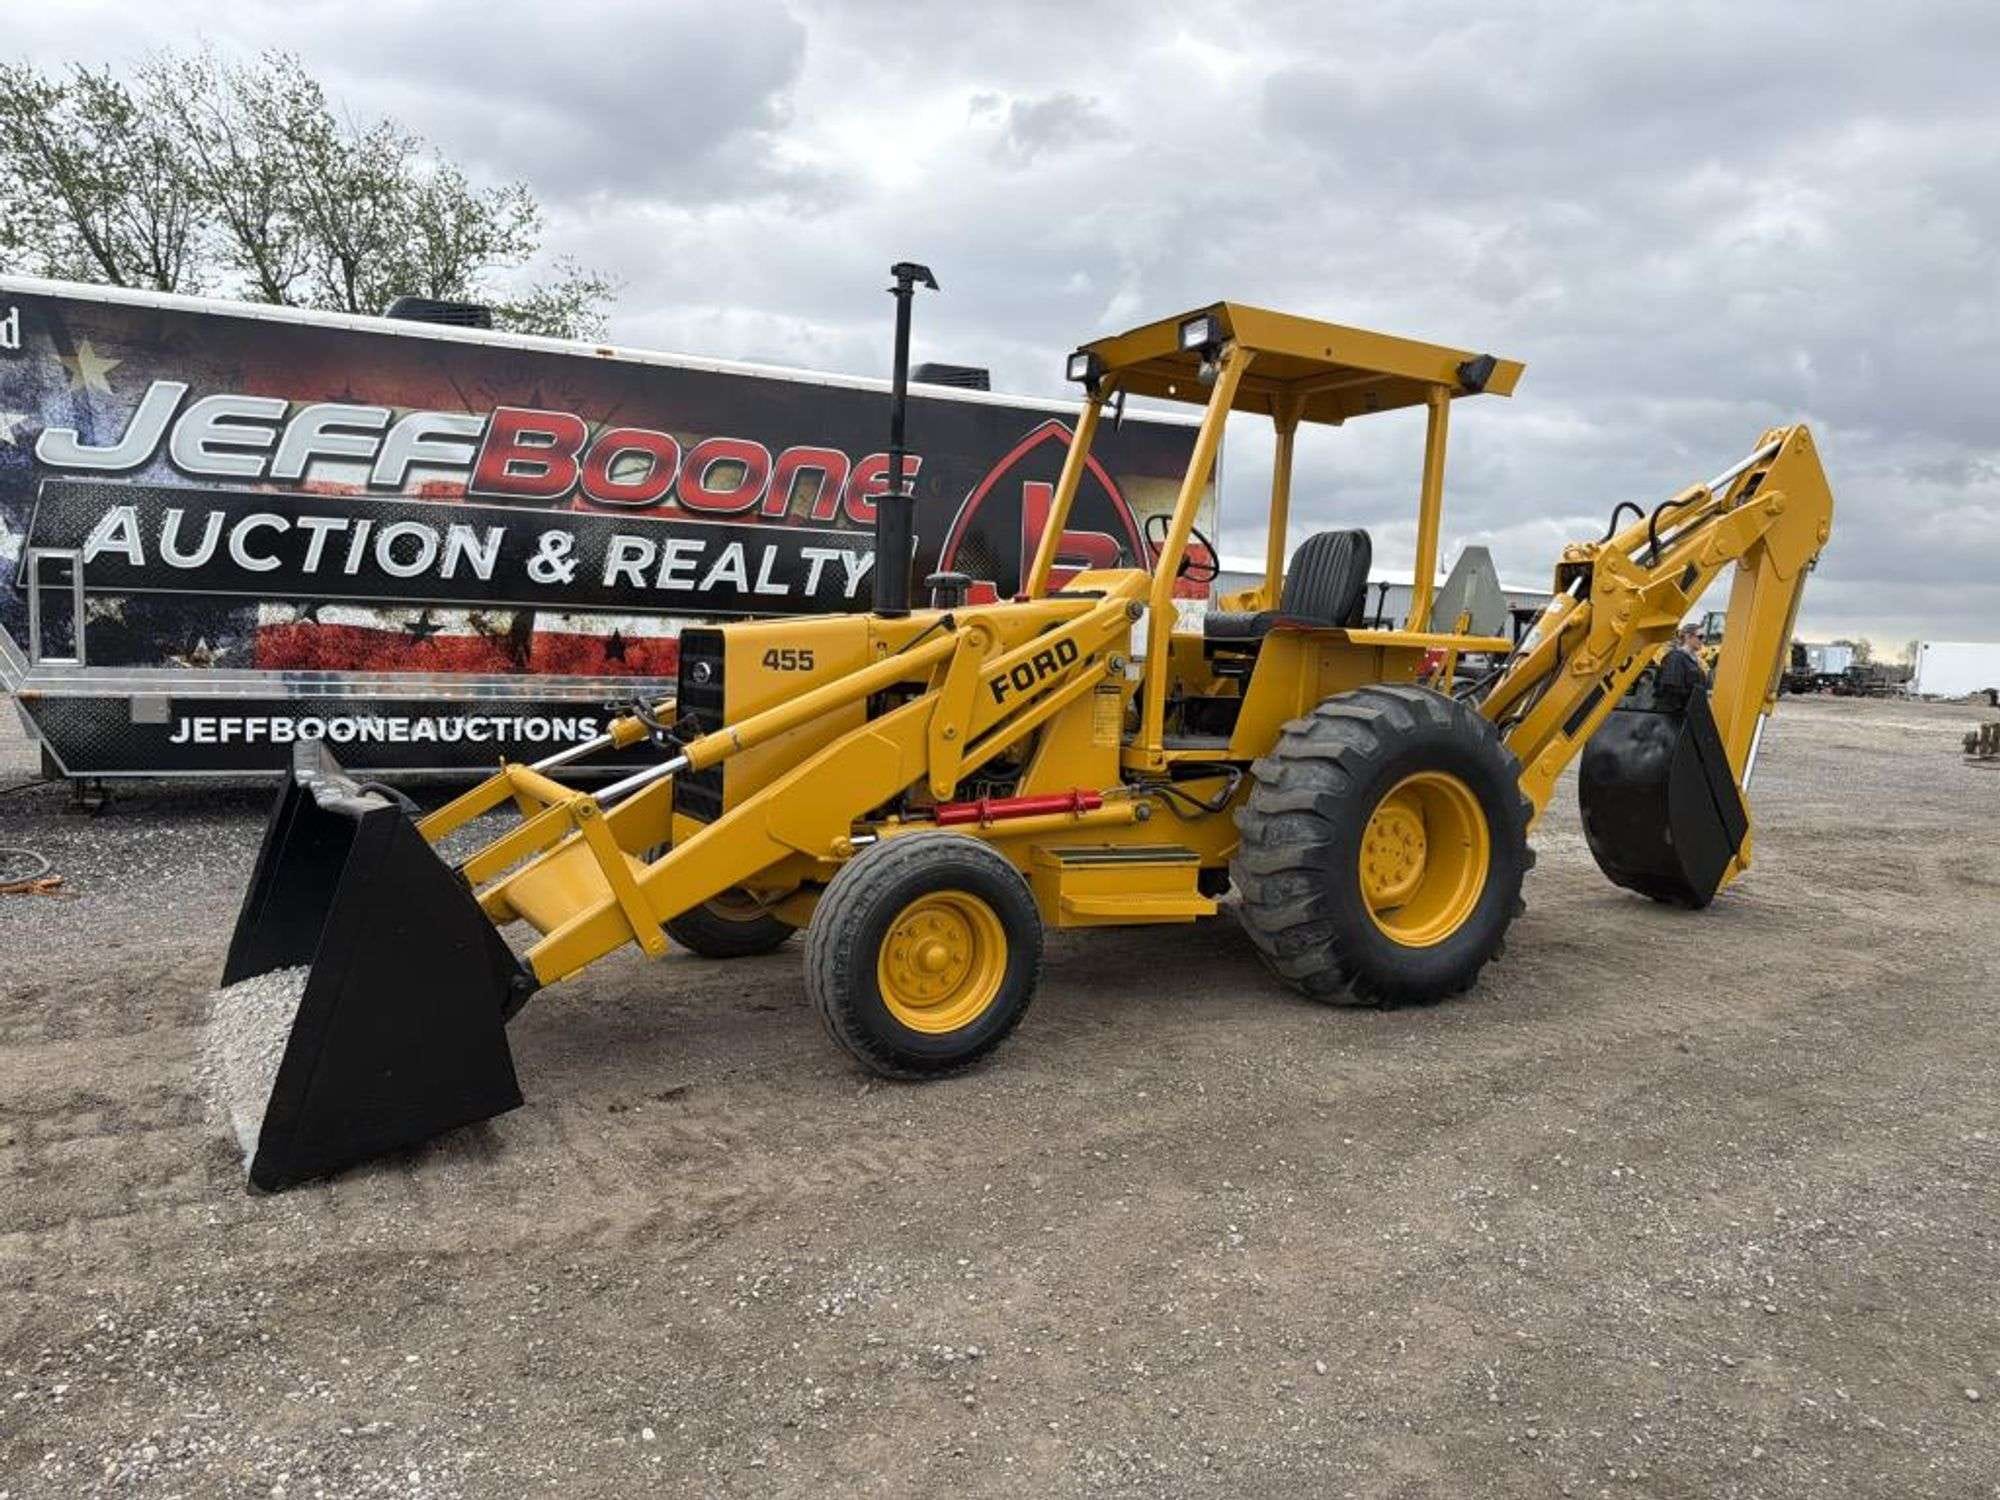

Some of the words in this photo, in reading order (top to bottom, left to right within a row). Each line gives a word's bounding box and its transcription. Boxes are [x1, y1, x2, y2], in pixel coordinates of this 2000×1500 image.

[82, 504, 507, 582] AUCTION
[526, 530, 580, 585] &
[602, 534, 876, 599] REALTY
[762, 648, 815, 672] 455
[989, 636, 1079, 705] FORD
[168, 716, 599, 744] JEFFBOONEAUCTIONS
